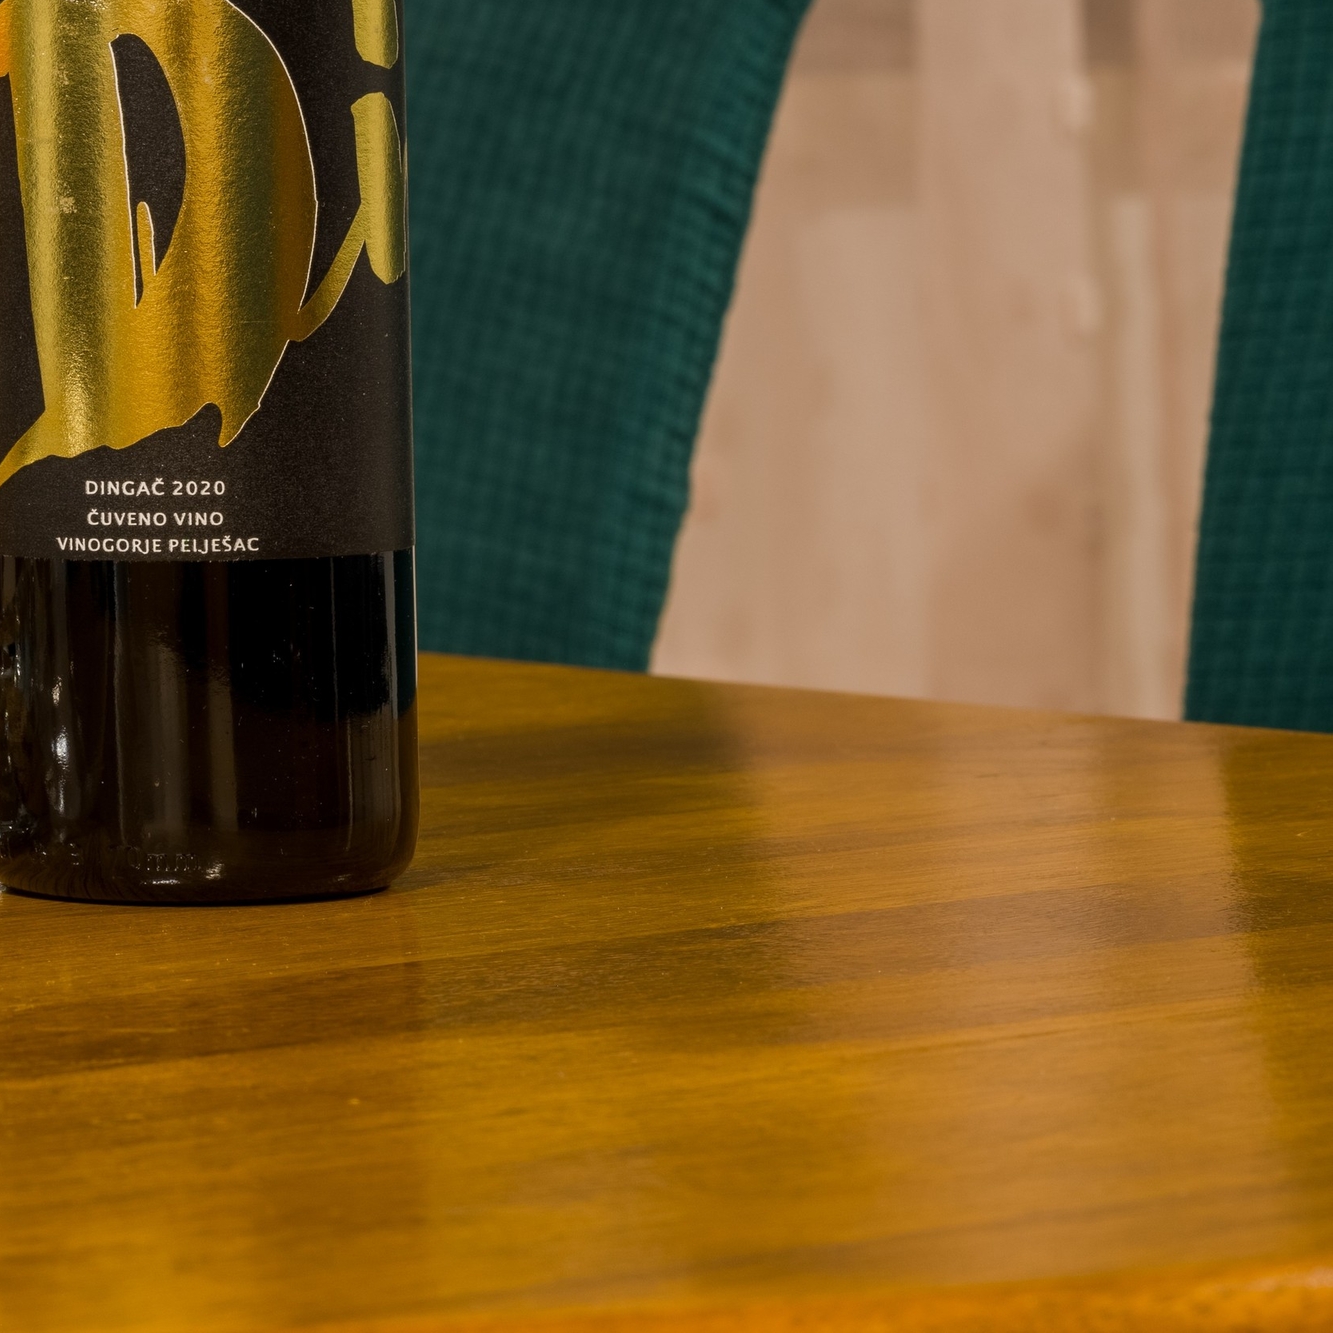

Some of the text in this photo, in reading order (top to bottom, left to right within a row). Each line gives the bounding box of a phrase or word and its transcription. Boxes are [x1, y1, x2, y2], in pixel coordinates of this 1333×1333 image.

[85, 478, 226, 497] DINGAČ 2020
[87, 508, 224, 526] ČUVENO VINO
[56, 535, 260, 555] VINOGORJE PELJEŠAC
